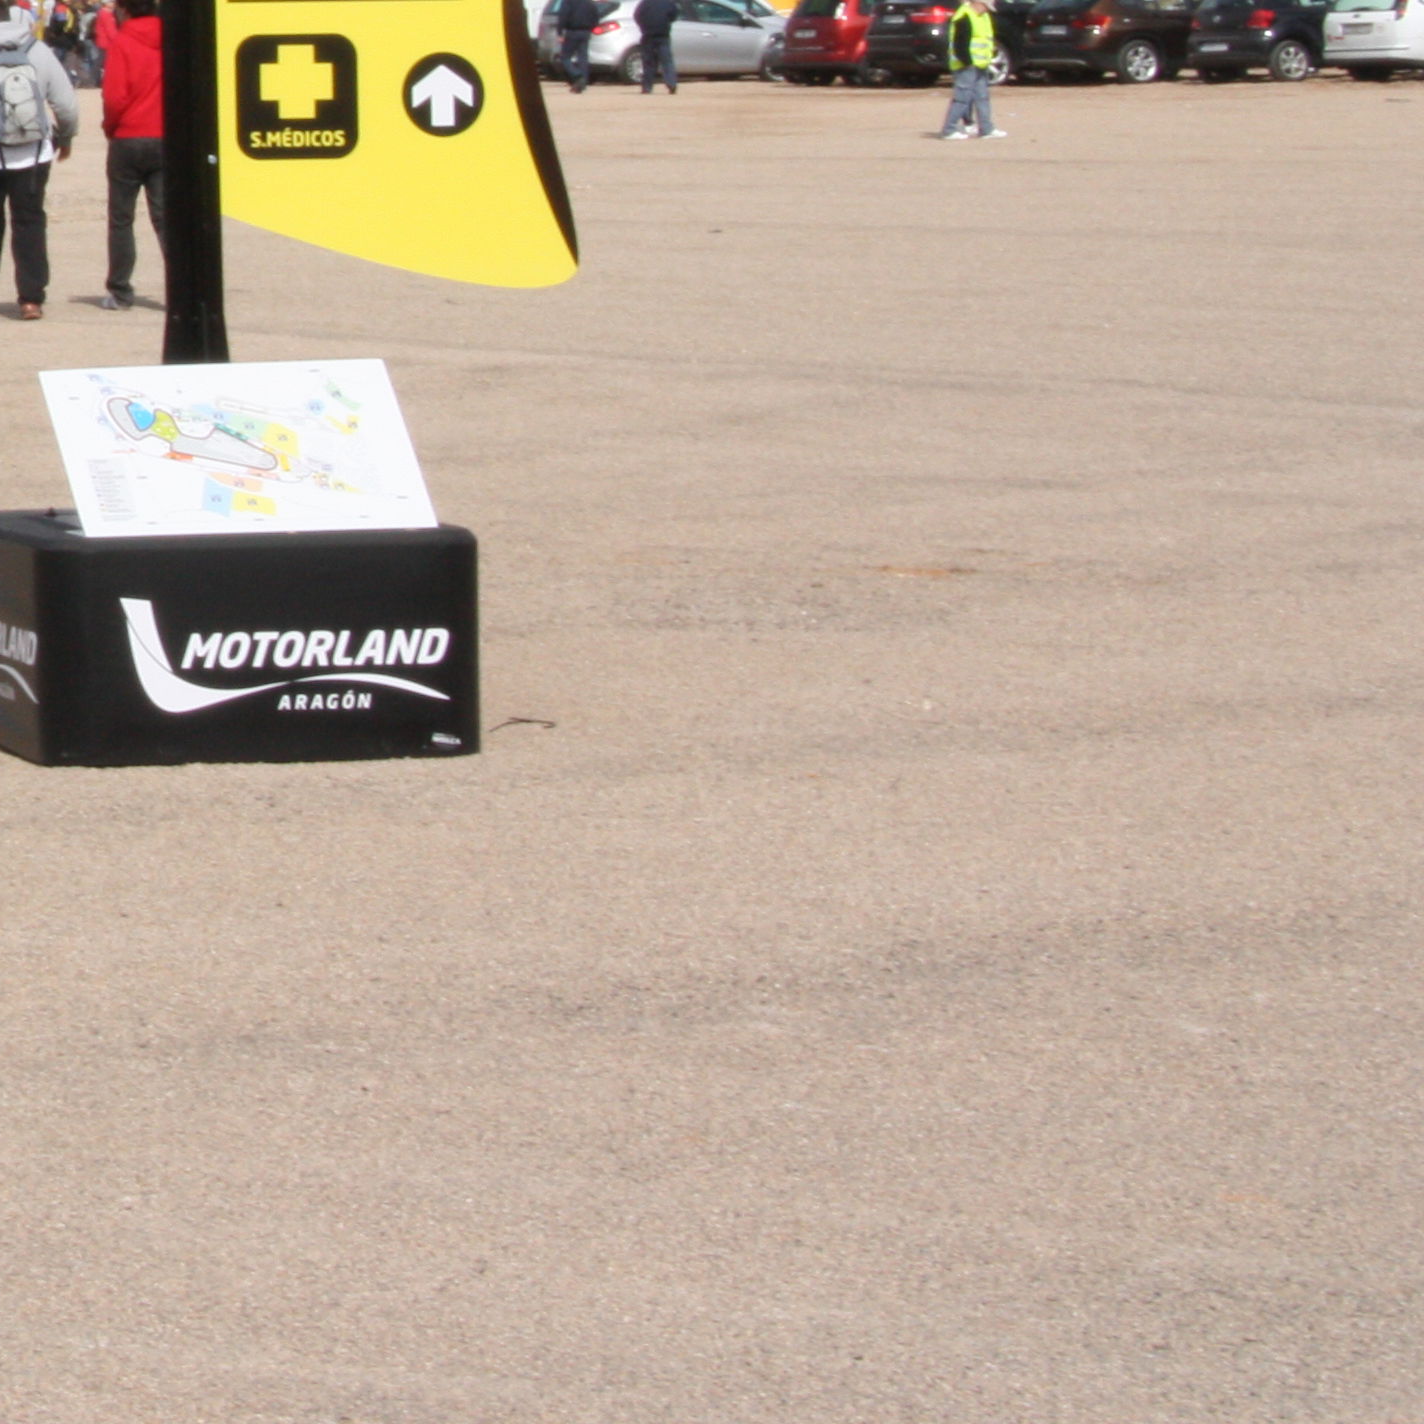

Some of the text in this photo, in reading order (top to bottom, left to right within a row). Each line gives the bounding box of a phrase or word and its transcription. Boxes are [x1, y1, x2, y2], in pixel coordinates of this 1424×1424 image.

[250, 127, 346, 148] S.MÉDICOS
[181, 628, 451, 670] MOTORLAND
[277, 689, 372, 711] ARAGÓN
